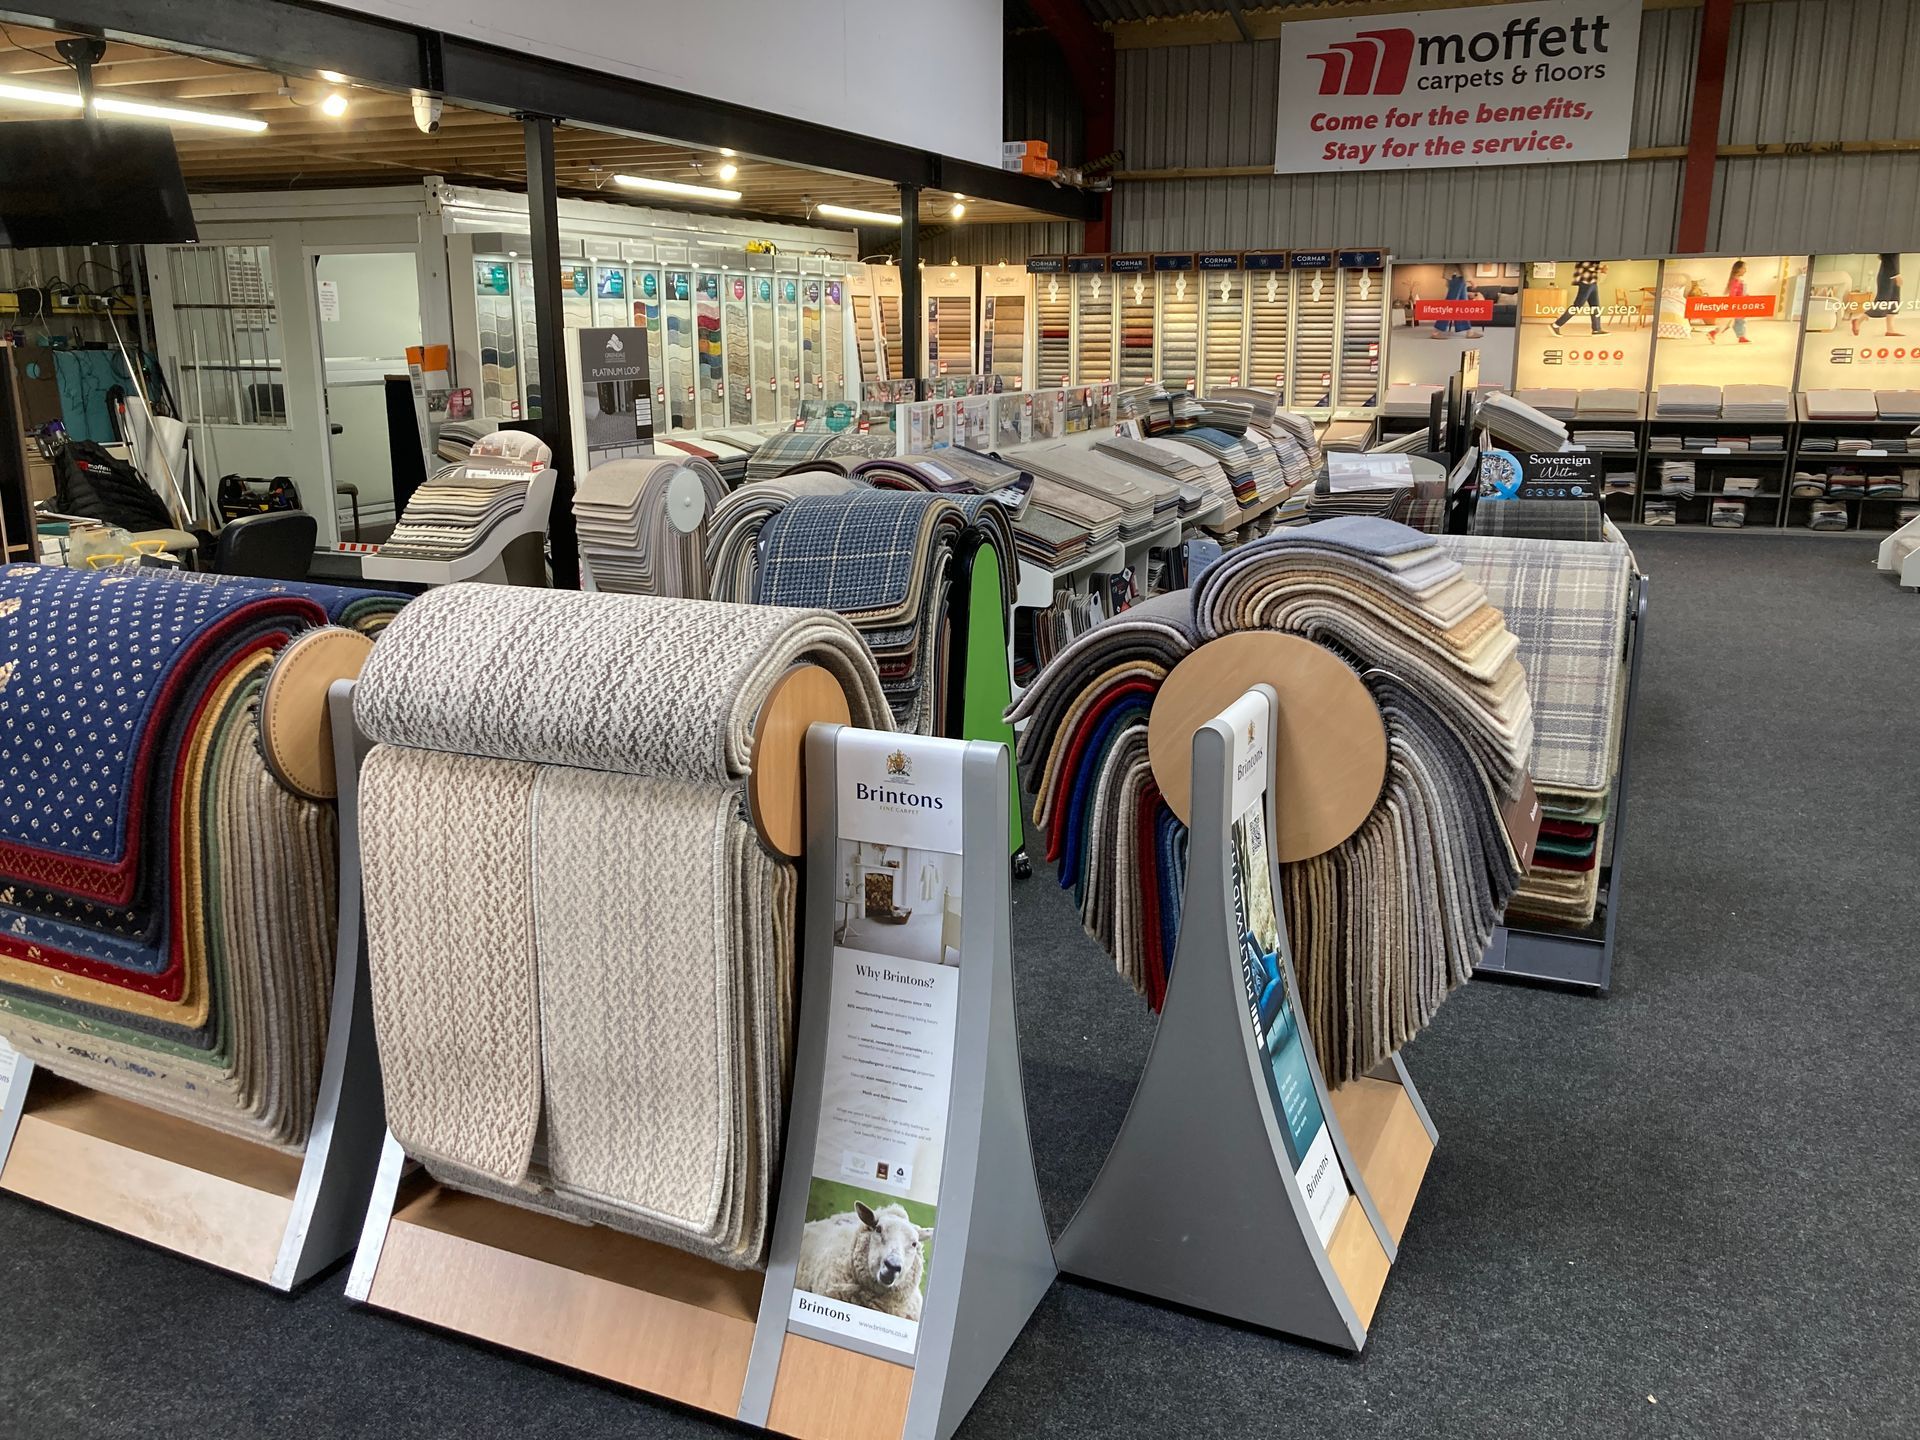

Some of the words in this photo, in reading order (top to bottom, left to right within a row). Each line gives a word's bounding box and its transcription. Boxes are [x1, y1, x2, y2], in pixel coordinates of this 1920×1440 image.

[1418, 15, 1610, 66] moffett
[1417, 68, 1504, 93] carpets
[1511, 65, 1527, 85] &
[1535, 61, 1606, 84] floors
[1310, 112, 1379, 132] Come
[1385, 107, 1423, 130] for
[1428, 103, 1469, 127] the
[1475, 97, 1594, 124] benefits,
[1322, 140, 1376, 164] Stay
[1380, 137, 1419, 160] for
[1424, 134, 1465, 157] the
[1472, 130, 1573, 154] service.
[1423, 305, 1454, 315] lifestyle
[1455, 306, 1485, 314] FLOORS
[1535, 303, 1566, 315] Love
[1568, 306, 1605, 318] every
[1607, 304, 1640, 317] step.
[1694, 302, 1729, 313] lifestyle
[1731, 302, 1766, 311] FLOORS
[1824, 299, 1859, 311] Love
[1862, 300, 1904, 313] every
[592, 367, 624, 377] PLATINUM
[624, 366, 641, 376] LOOP
[1529, 453, 1592, 467] Sovereign
[1540, 464, 1580, 479] Wilton
[857, 782, 943, 810] Brintons
[856, 964, 881, 980] Why
[883, 969, 935, 989] Brintons?
[1305, 1154, 1330, 1200] Brintons
[798, 1298, 851, 1322] Brintons
